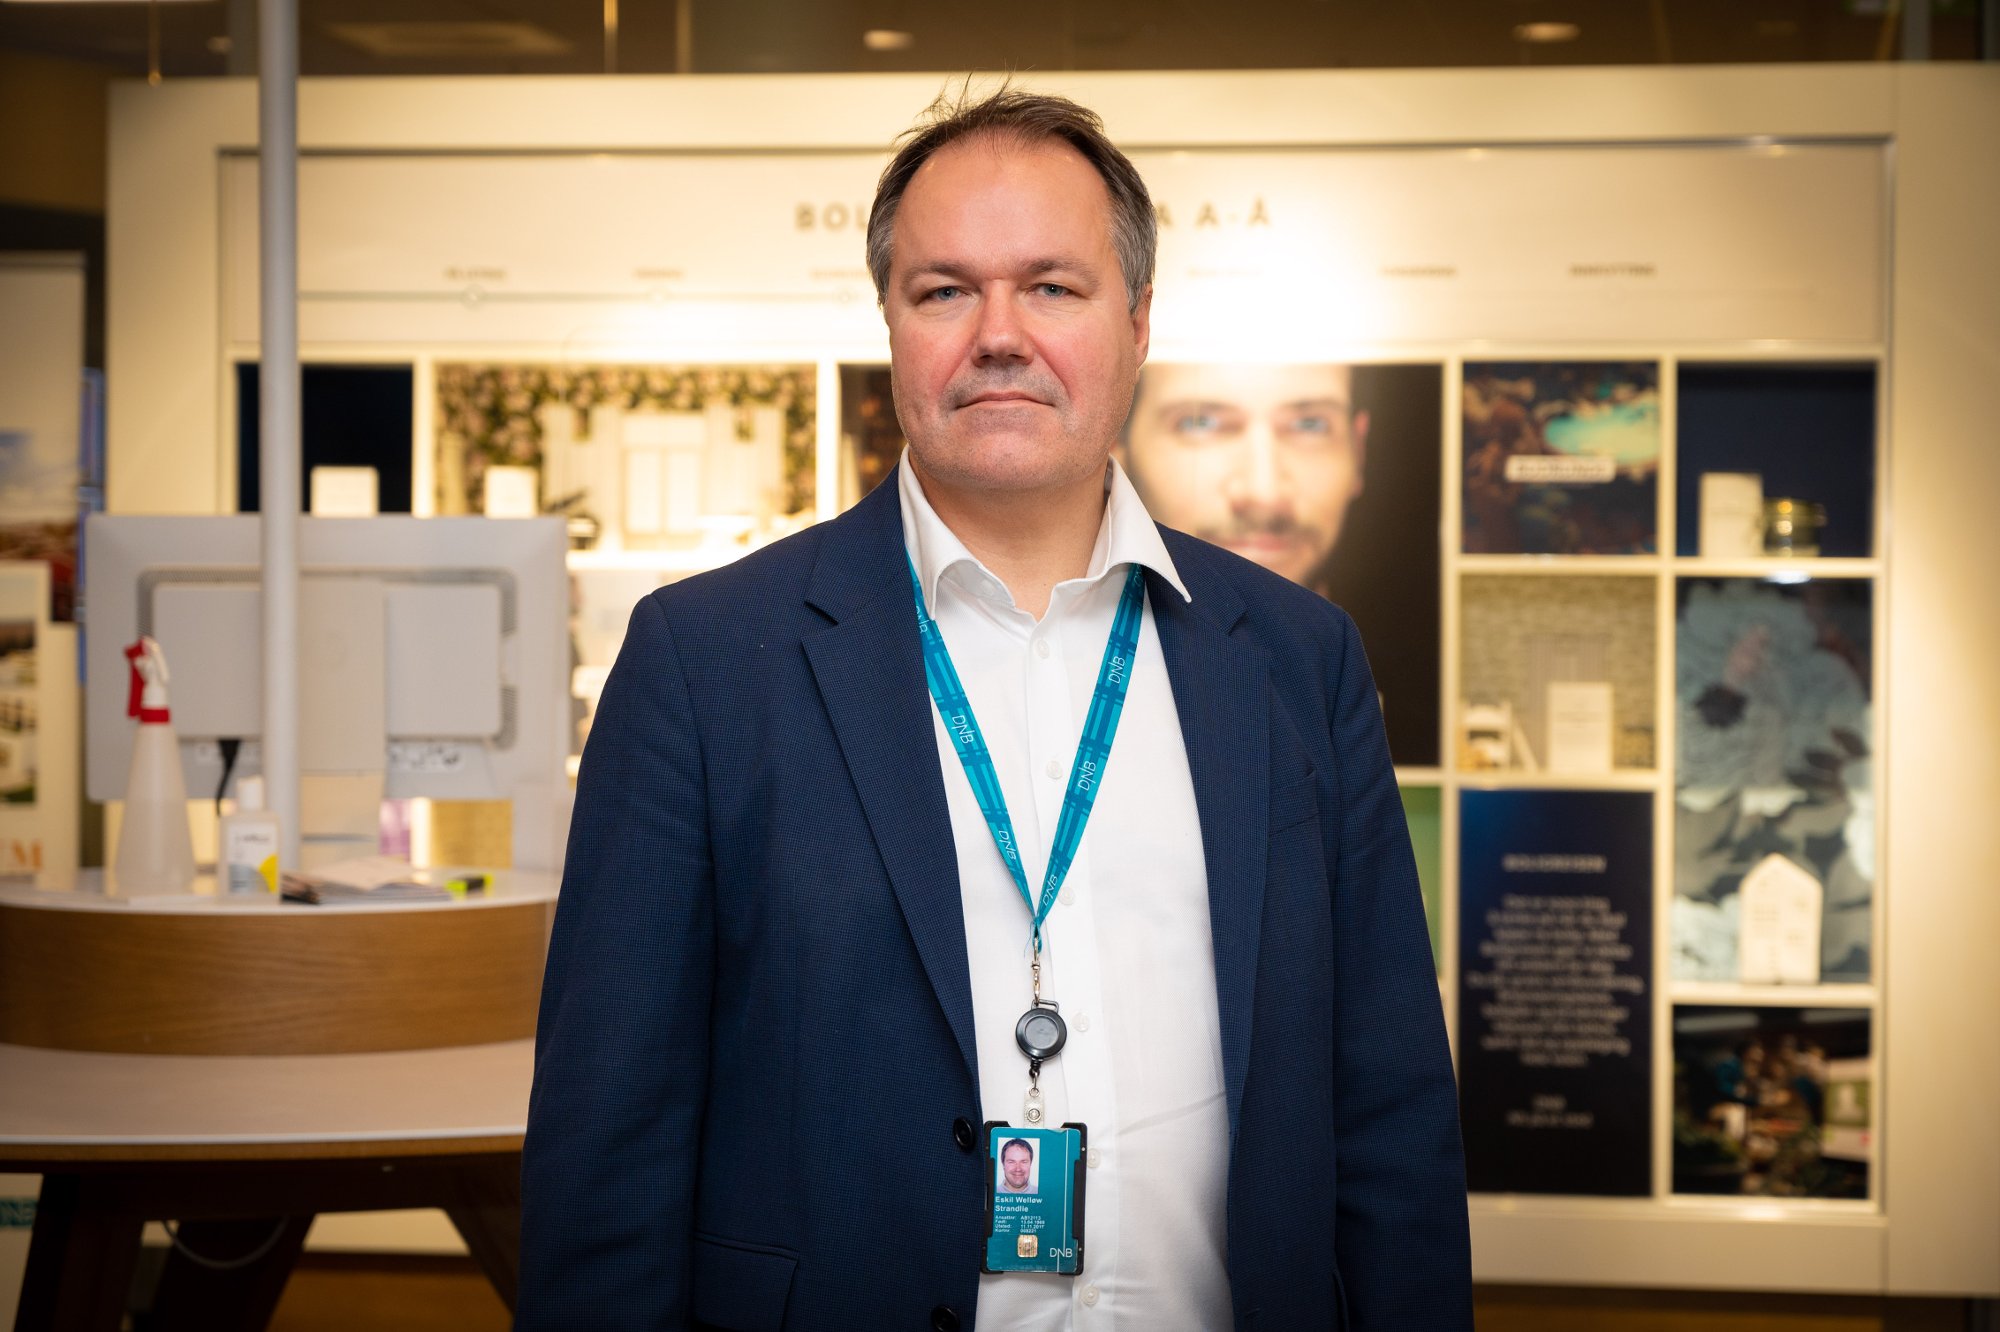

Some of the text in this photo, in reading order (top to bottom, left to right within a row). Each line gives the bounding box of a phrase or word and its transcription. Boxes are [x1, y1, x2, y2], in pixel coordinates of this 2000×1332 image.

[795, 203, 868, 232] BOL
[1108, 655, 1126, 684] DNB
[951, 714, 975, 744] DNB
[1077, 760, 1097, 791] DNB
[998, 830, 1017, 860] DNB
[1042, 874, 1058, 906] DNB
[1049, 1248, 1073, 1258] DNB
